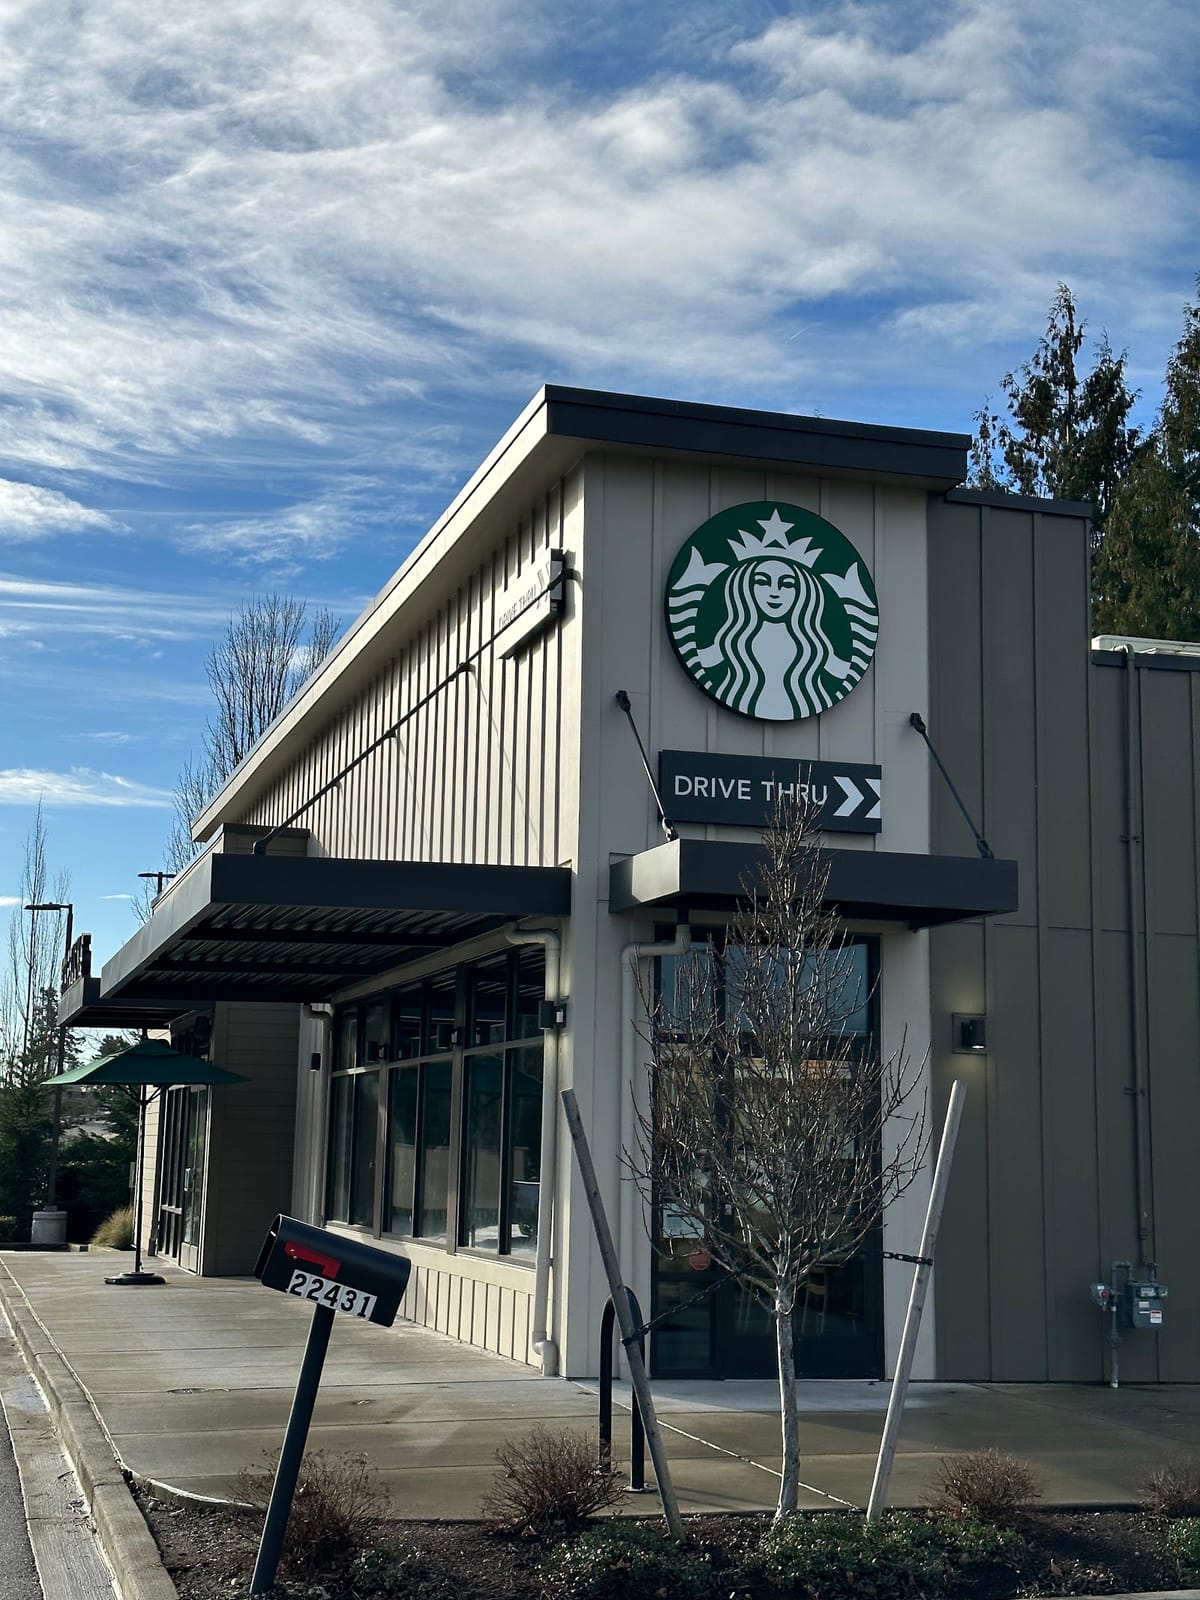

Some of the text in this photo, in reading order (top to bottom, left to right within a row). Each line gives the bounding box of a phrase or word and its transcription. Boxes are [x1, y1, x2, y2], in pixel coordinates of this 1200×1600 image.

[674, 775, 827, 805] DRIVE THRU
[289, 1273, 371, 1318] 22431
